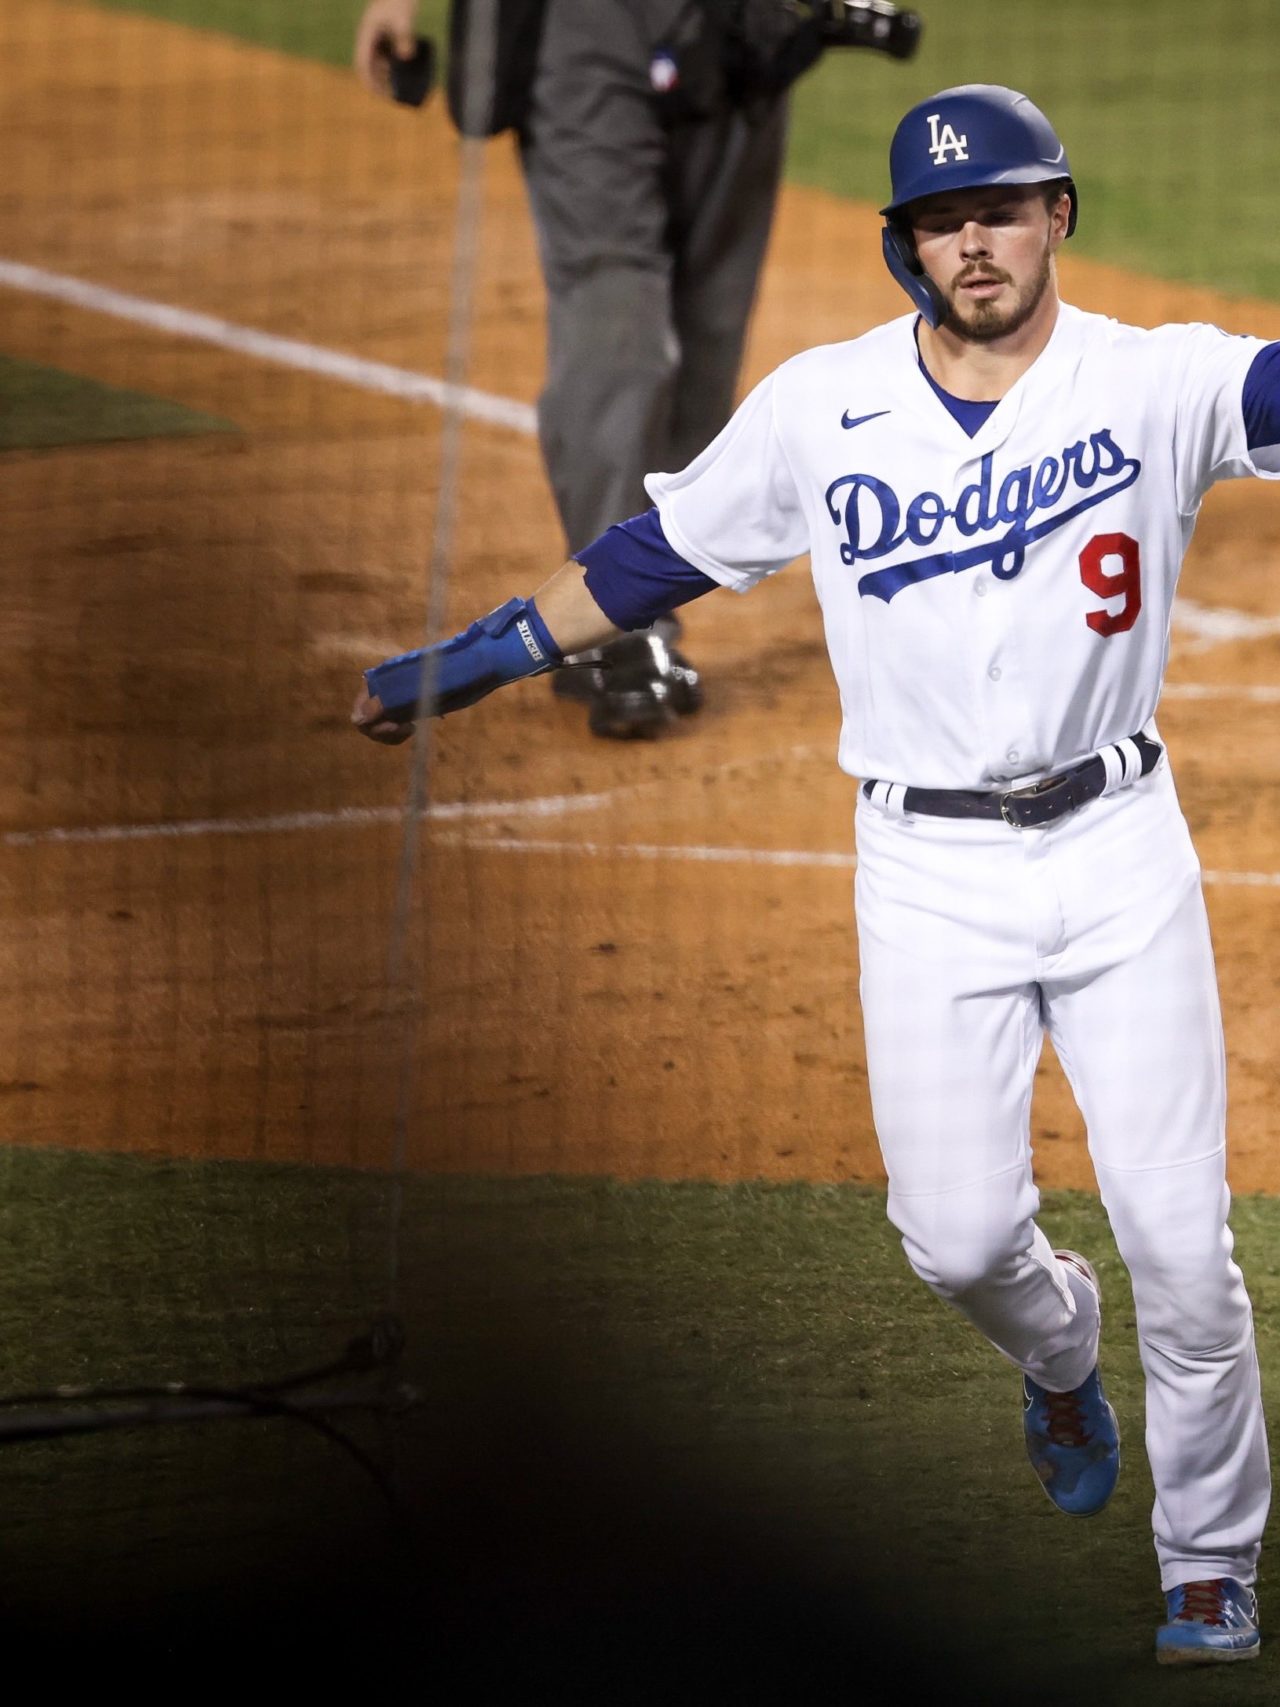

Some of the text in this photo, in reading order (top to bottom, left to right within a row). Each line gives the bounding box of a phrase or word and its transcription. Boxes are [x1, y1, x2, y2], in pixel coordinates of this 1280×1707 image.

[927, 114, 969, 165] LA
[825, 428, 1141, 604] Dodgers
[1078, 532, 1142, 638] 9
